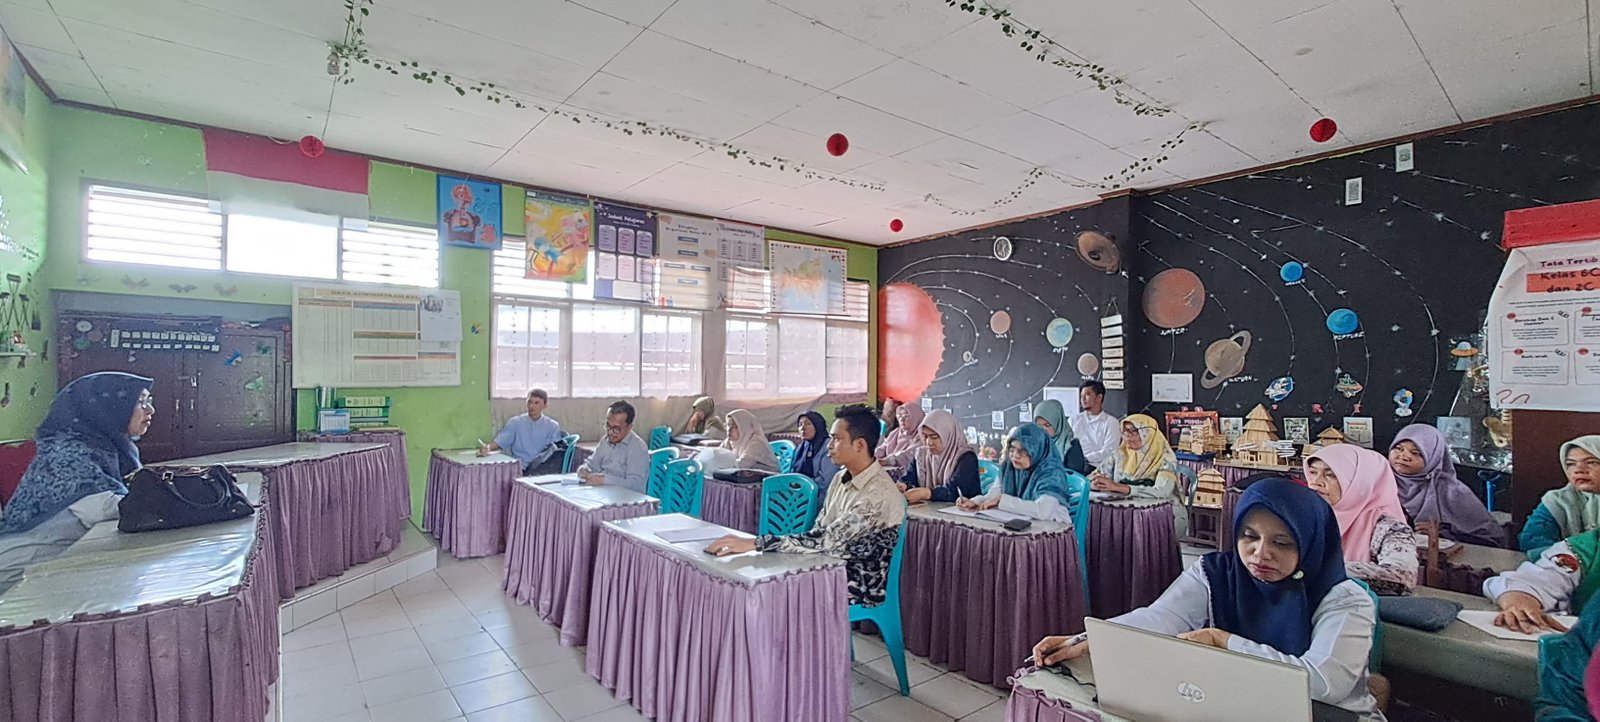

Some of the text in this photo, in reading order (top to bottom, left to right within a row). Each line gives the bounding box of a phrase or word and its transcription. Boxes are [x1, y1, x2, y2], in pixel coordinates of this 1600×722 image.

[1540, 256, 1598, 268] Tata Tertib
[1540, 267, 1600, 280] Kelas 6C
[1547, 281, 1595, 293] dan 2C
